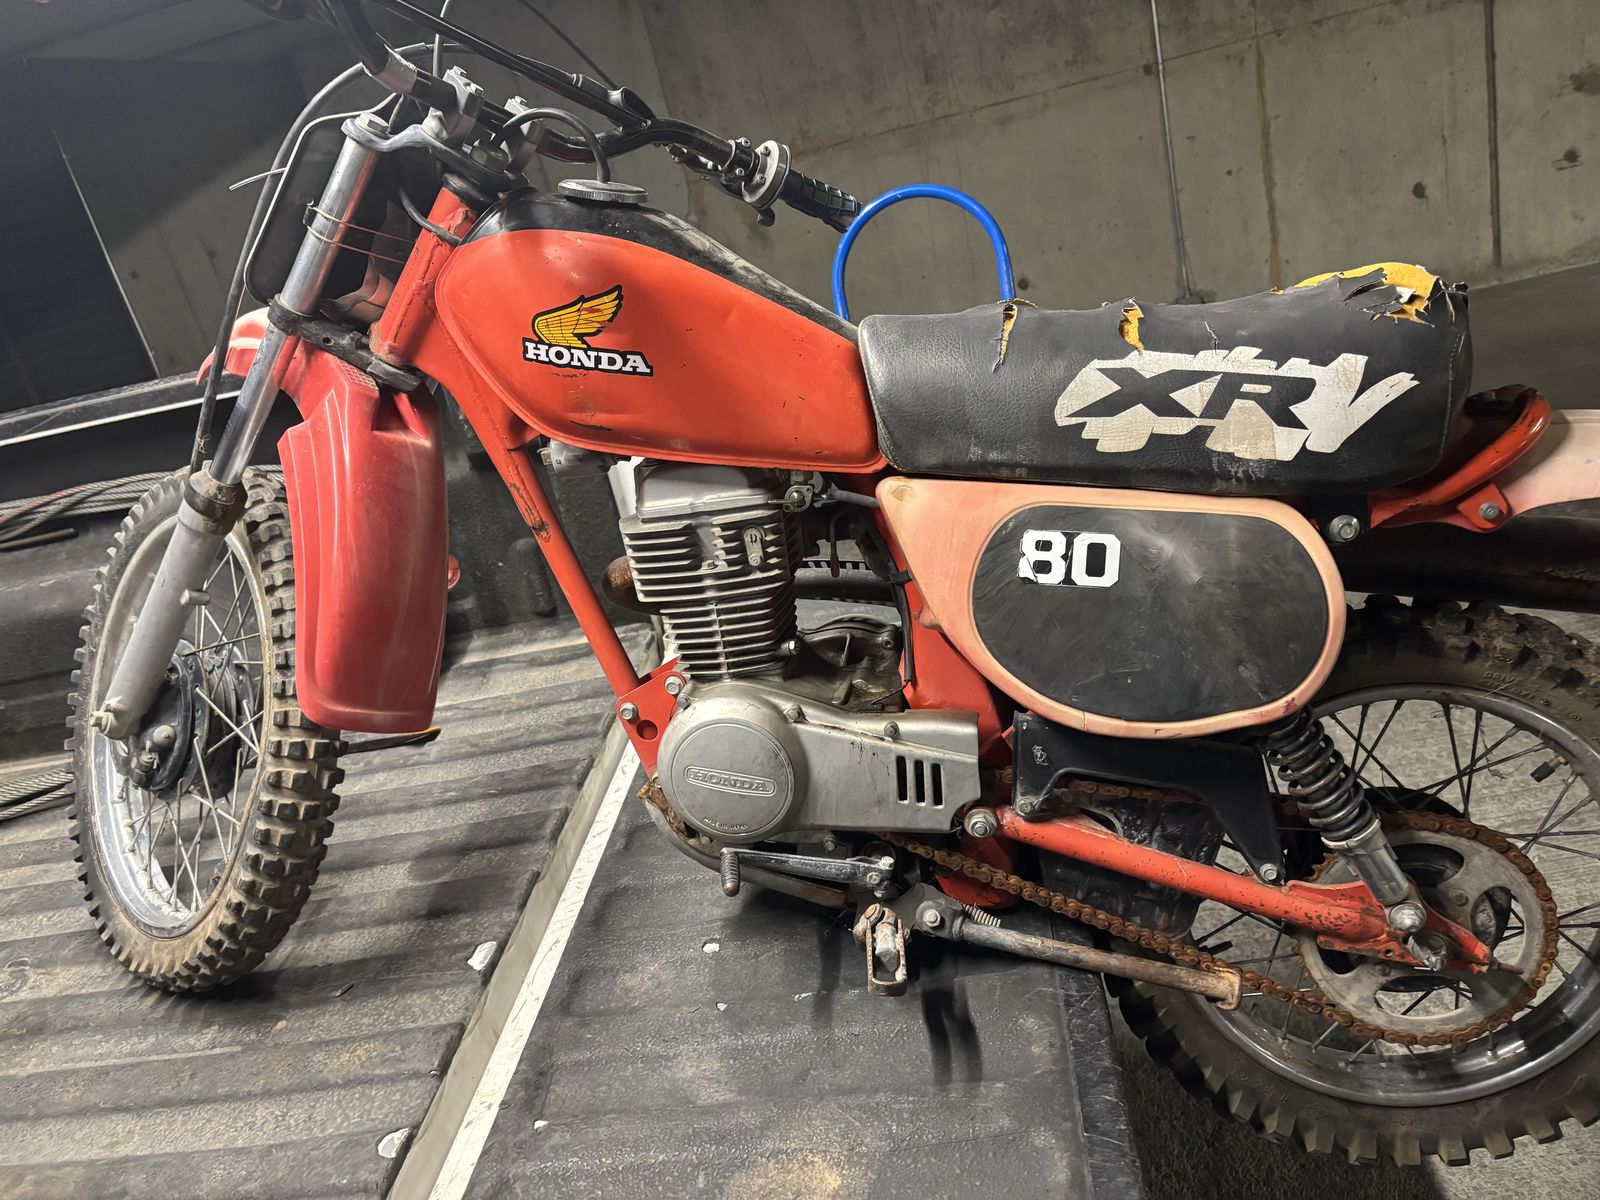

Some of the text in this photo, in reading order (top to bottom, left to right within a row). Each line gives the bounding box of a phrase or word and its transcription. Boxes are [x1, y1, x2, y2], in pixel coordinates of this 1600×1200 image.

[525, 341, 651, 373] HONDA
[1018, 529, 1121, 587] 80
[689, 768, 771, 792] HONDA
[703, 815, 720, 828] MADE
[730, 823, 749, 831] JAPAN
